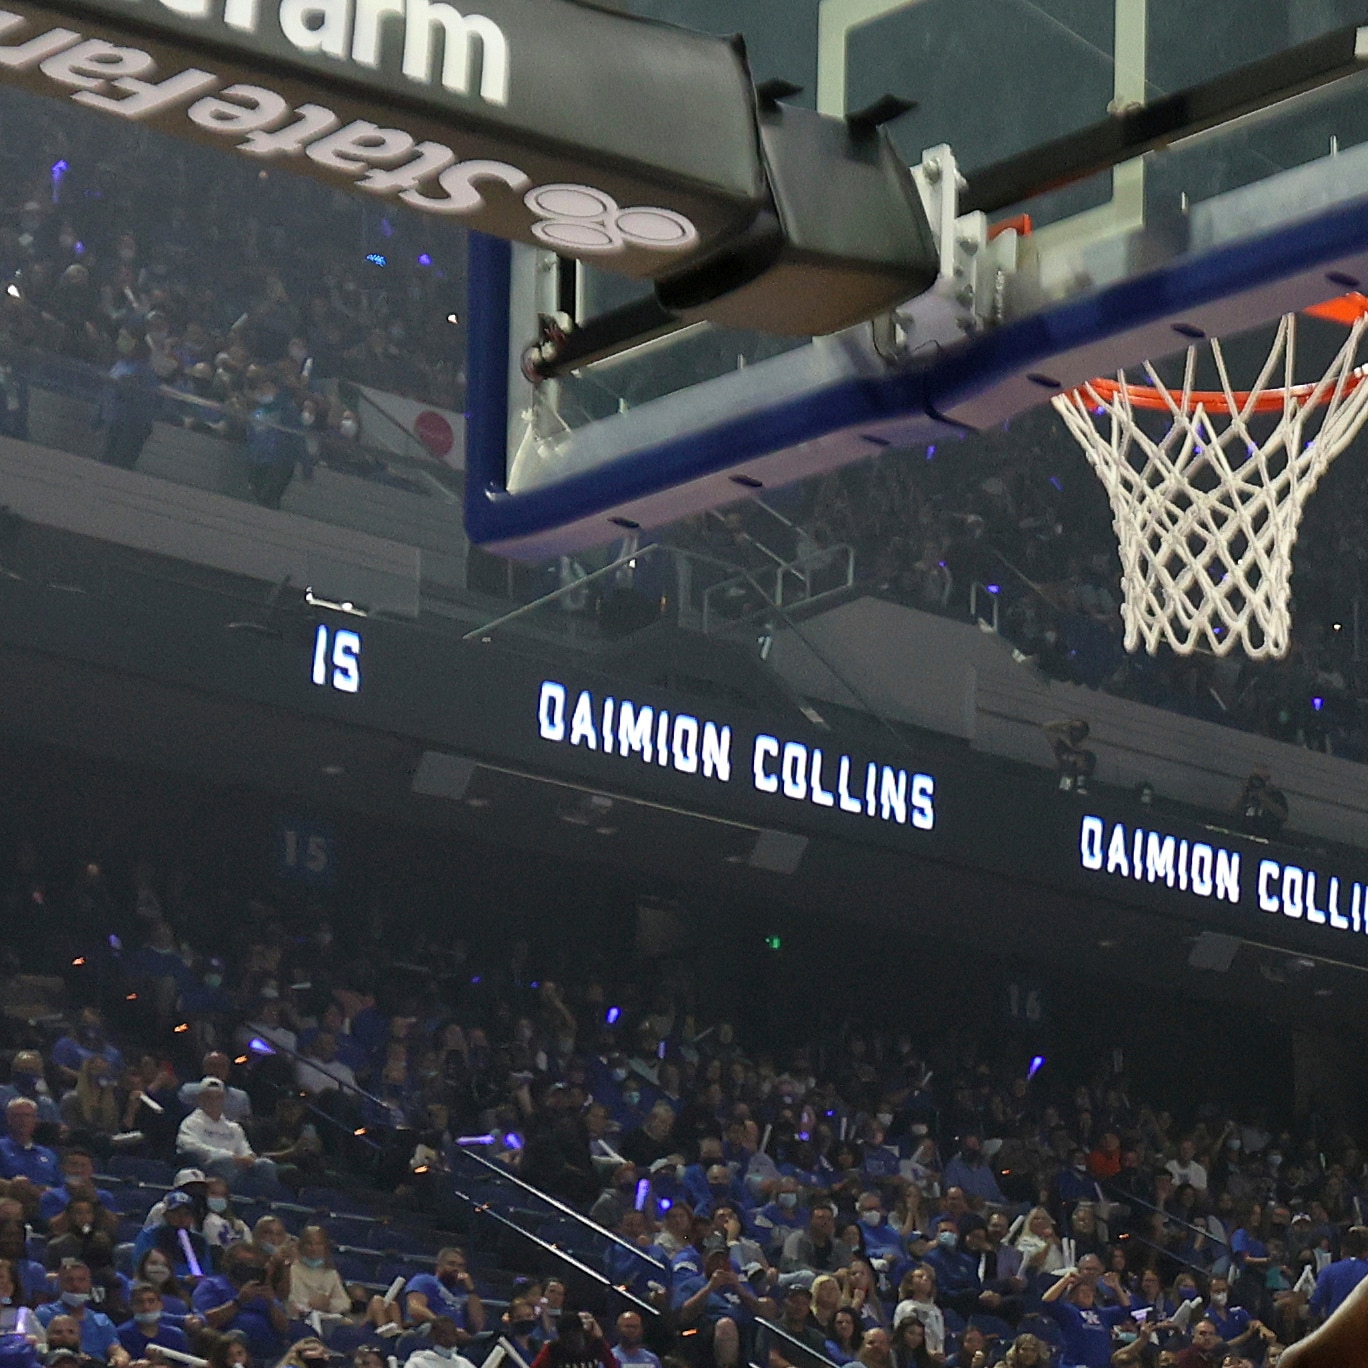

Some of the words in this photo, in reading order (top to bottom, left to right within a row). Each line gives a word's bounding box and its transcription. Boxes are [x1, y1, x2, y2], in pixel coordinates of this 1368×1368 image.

[537, 681, 732, 782] DAIMION
[752, 734, 935, 830] COLLINS
[1081, 815, 1240, 903] DAIMION
